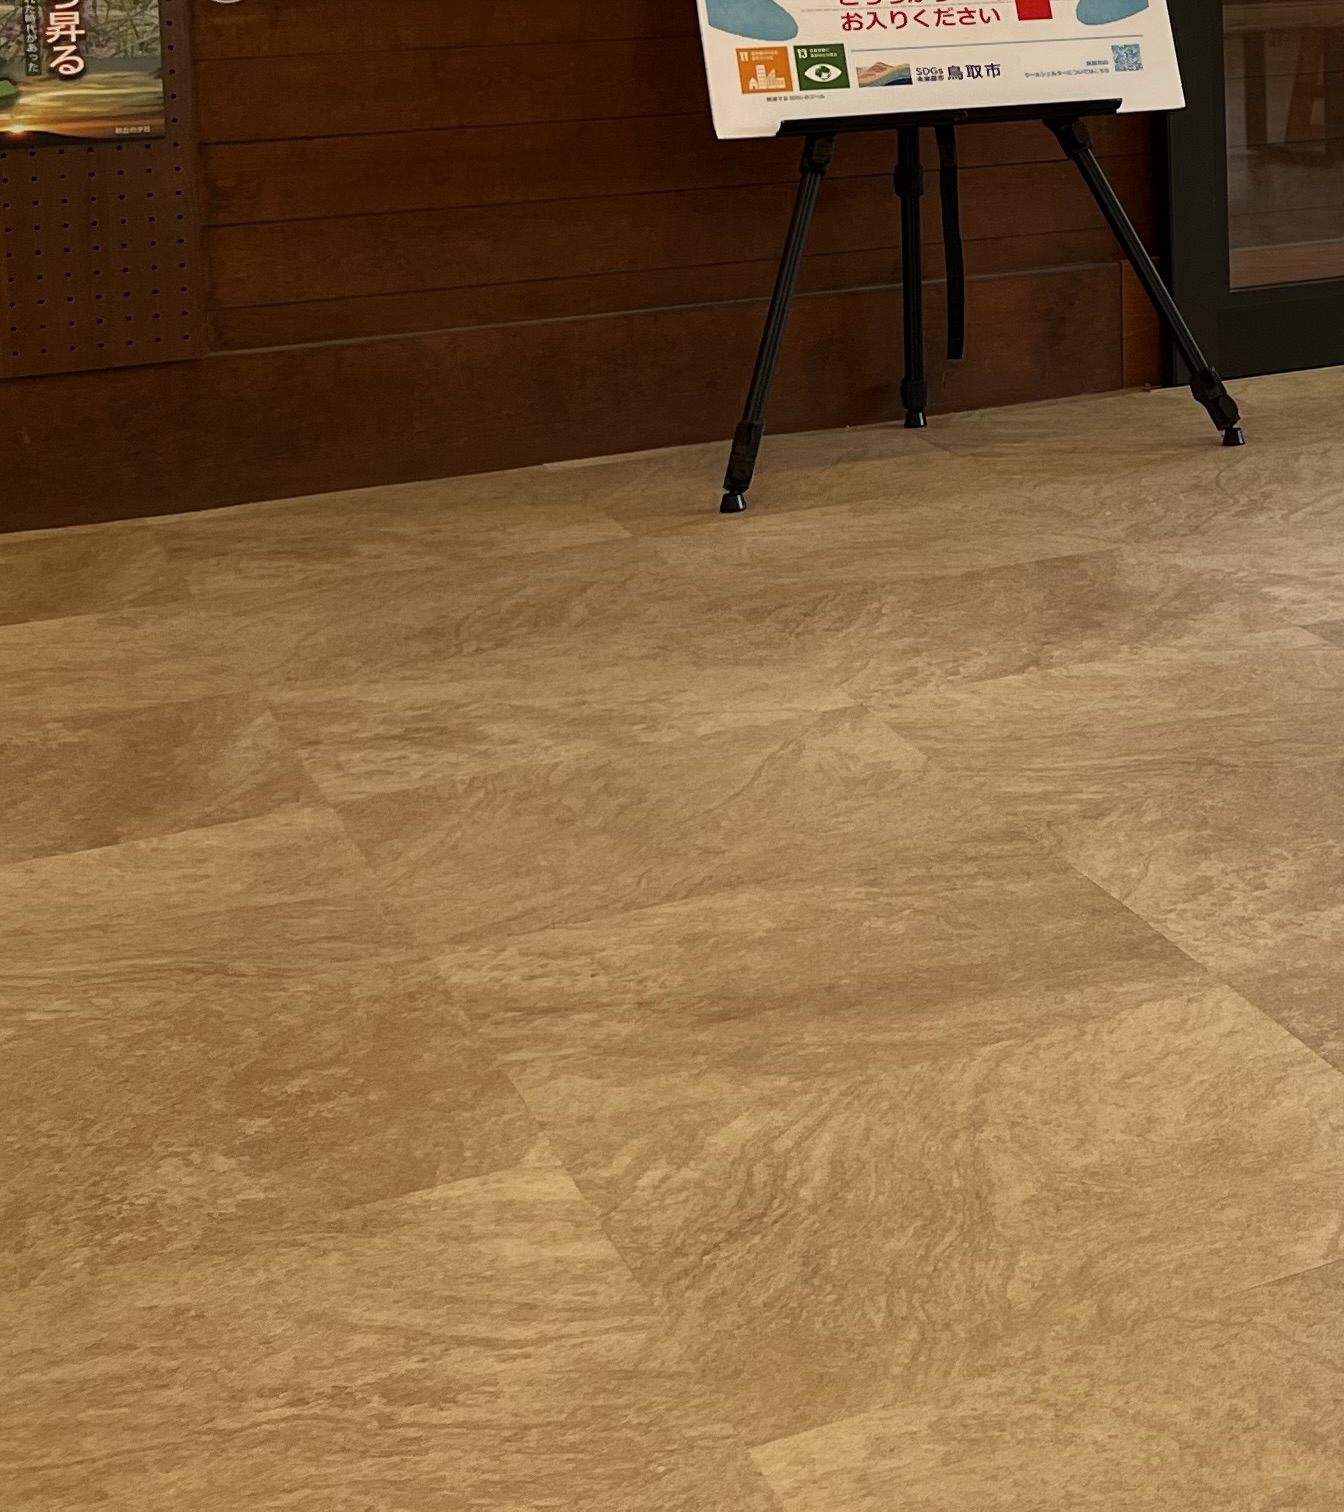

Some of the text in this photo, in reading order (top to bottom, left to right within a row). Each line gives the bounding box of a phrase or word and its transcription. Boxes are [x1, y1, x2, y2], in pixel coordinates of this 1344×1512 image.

[840, 6, 1001, 32] お入りください
[797, 48, 808, 59] 13
[915, 66, 944, 76] SDGs
[947, 63, 1001, 81] 鳥取市
